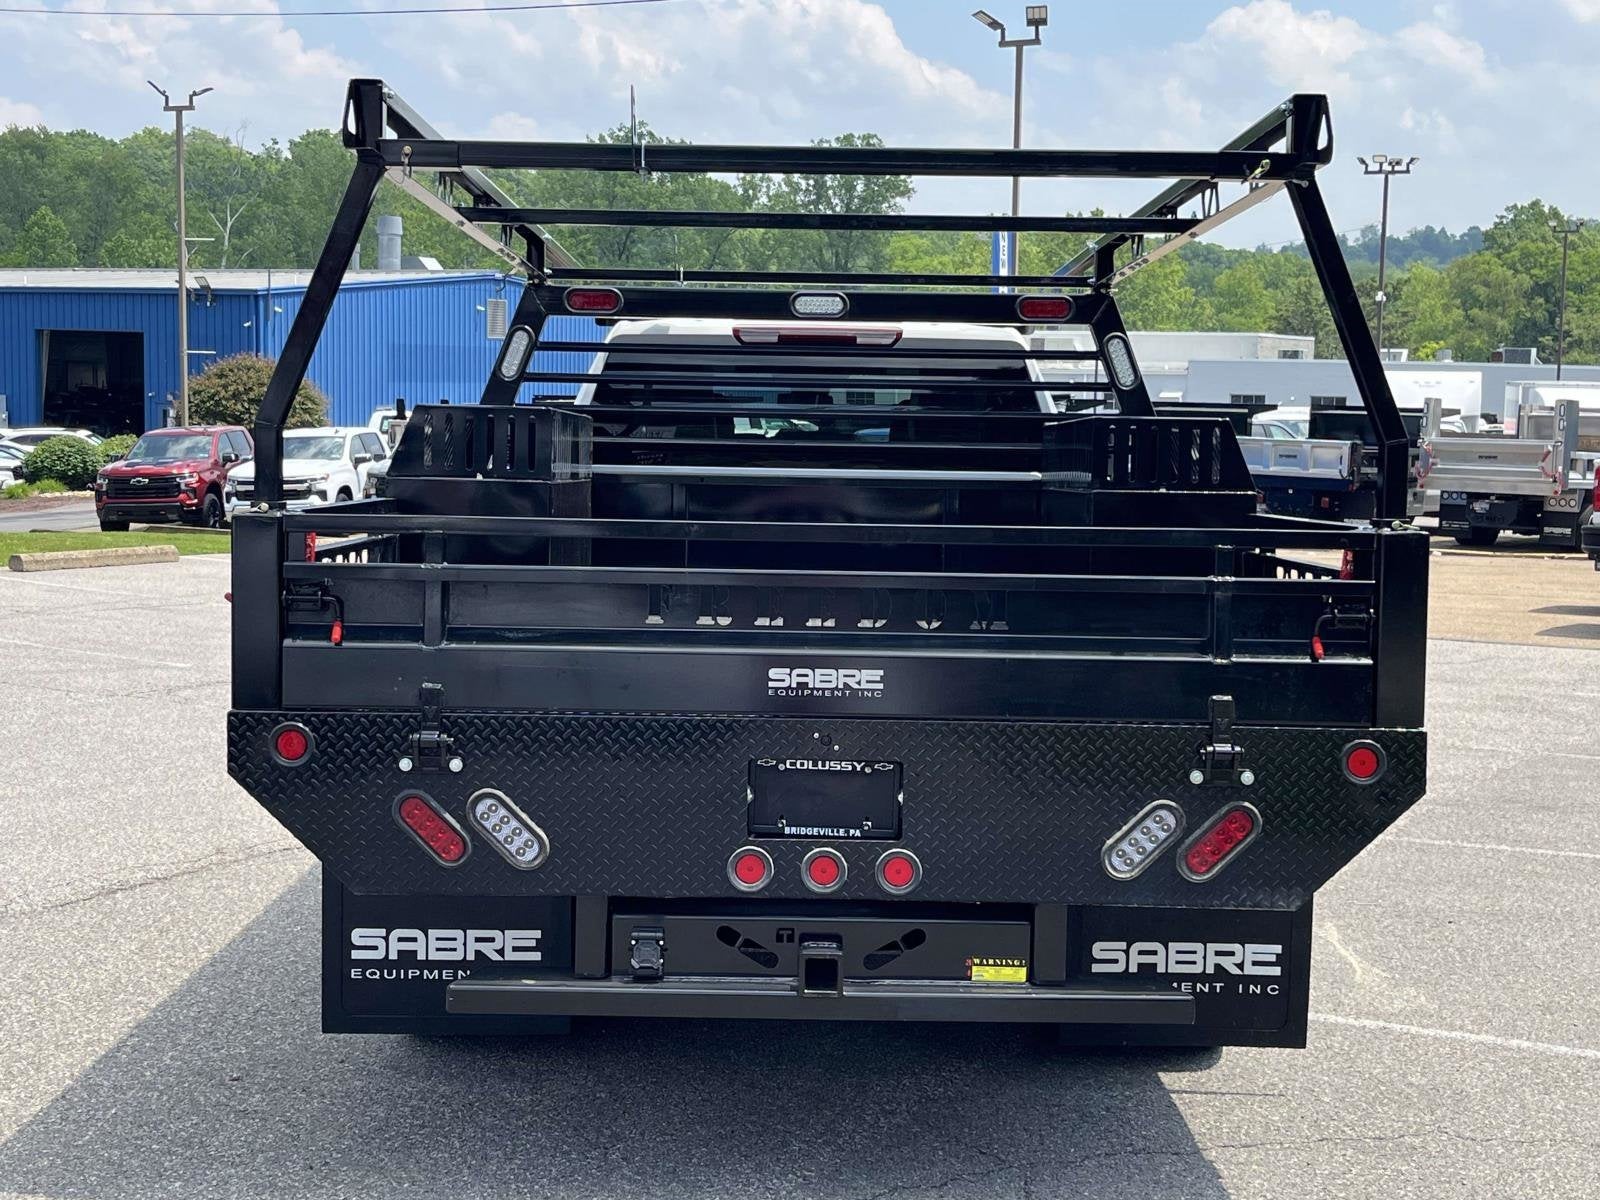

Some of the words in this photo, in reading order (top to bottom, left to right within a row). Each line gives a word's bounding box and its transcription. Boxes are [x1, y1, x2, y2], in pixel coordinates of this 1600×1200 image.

[767, 667, 884, 689] SABRE
[768, 689, 851, 697] EQUIPMENT
[858, 690, 882, 698] INC
[786, 759, 865, 771] COLUSSY
[849, 828, 862, 838] PA
[350, 928, 542, 961] SABRE
[973, 958, 1026, 966] WARNING!
[1091, 941, 1282, 976] SABRE
[350, 968, 471, 980] EQUIPMEN
[1238, 983, 1280, 995] INC
